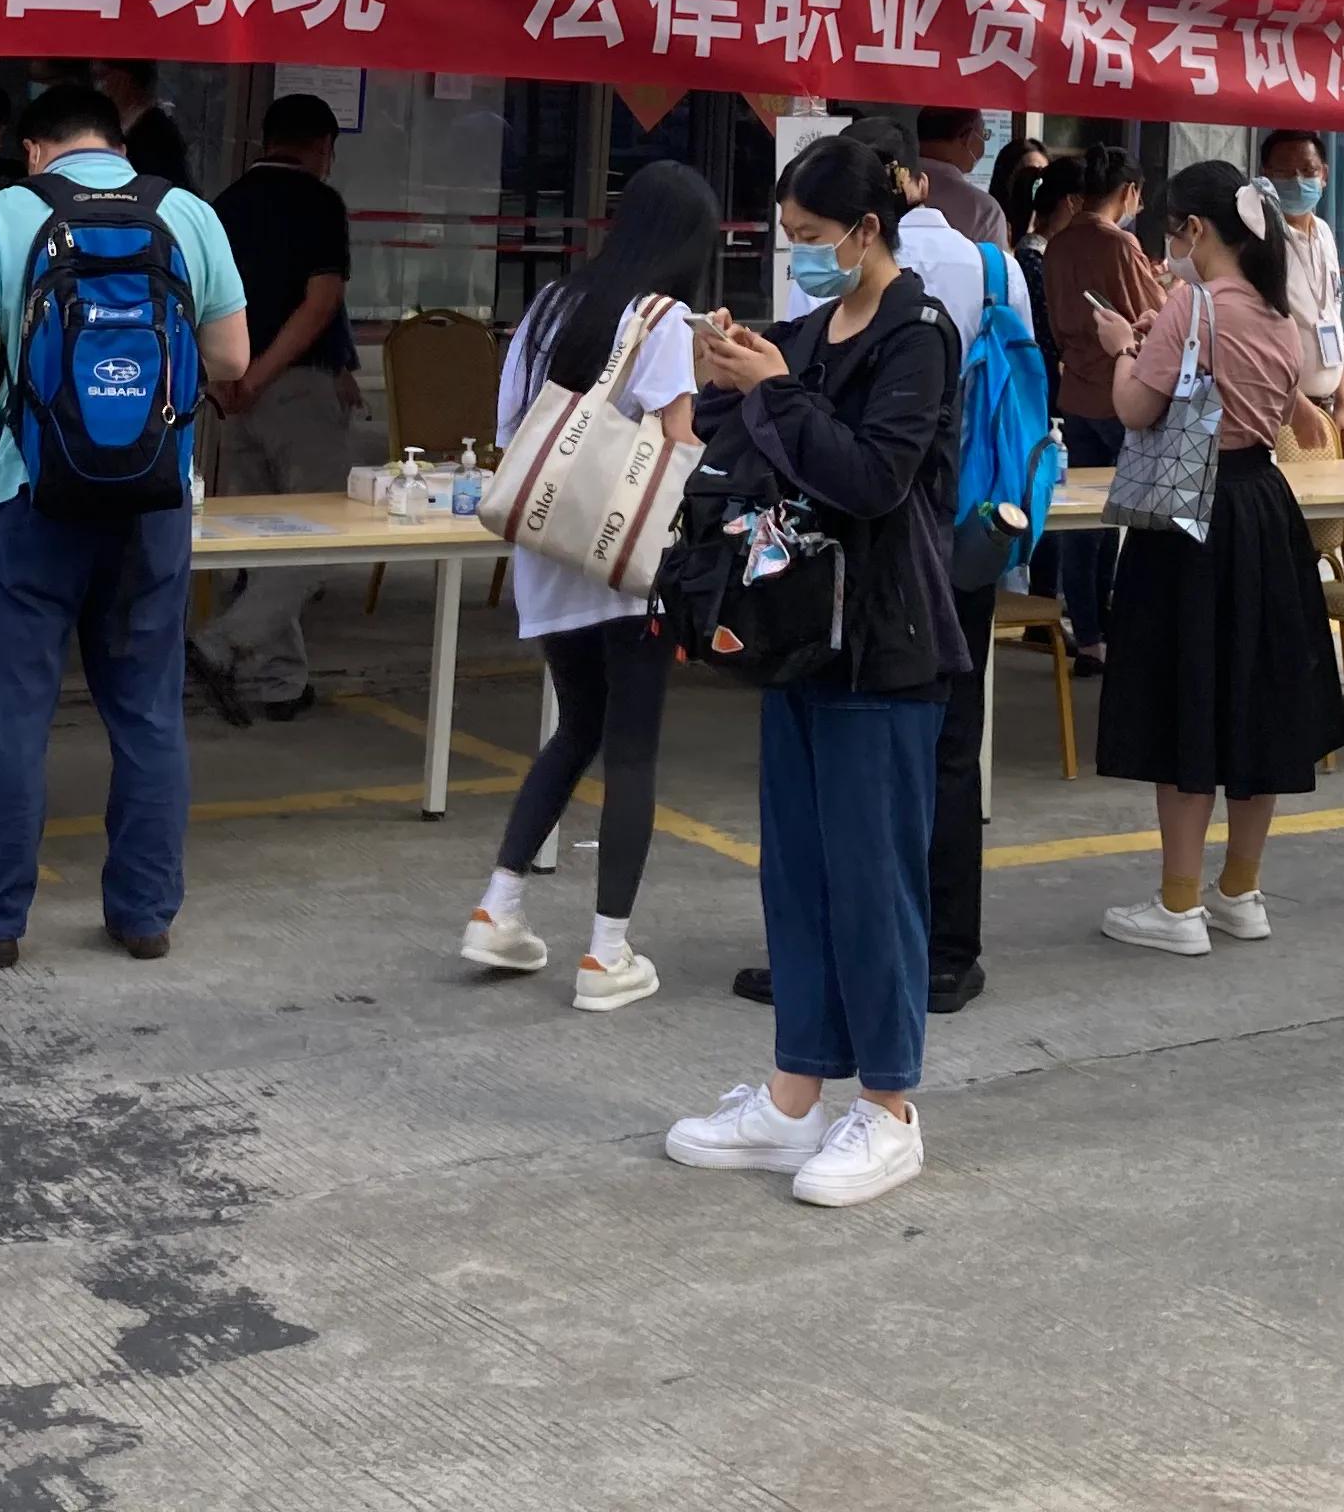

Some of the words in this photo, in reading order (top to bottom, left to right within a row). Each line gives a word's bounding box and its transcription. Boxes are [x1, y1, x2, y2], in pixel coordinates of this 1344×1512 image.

[91, 192, 138, 202] SUBARU
[87, 386, 147, 397] SUBARU
[559, 409, 593, 457] Chloé
[625, 440, 655, 487] Chloé
[527, 481, 558, 532] Chloé
[593, 510, 626, 561] Chloé
